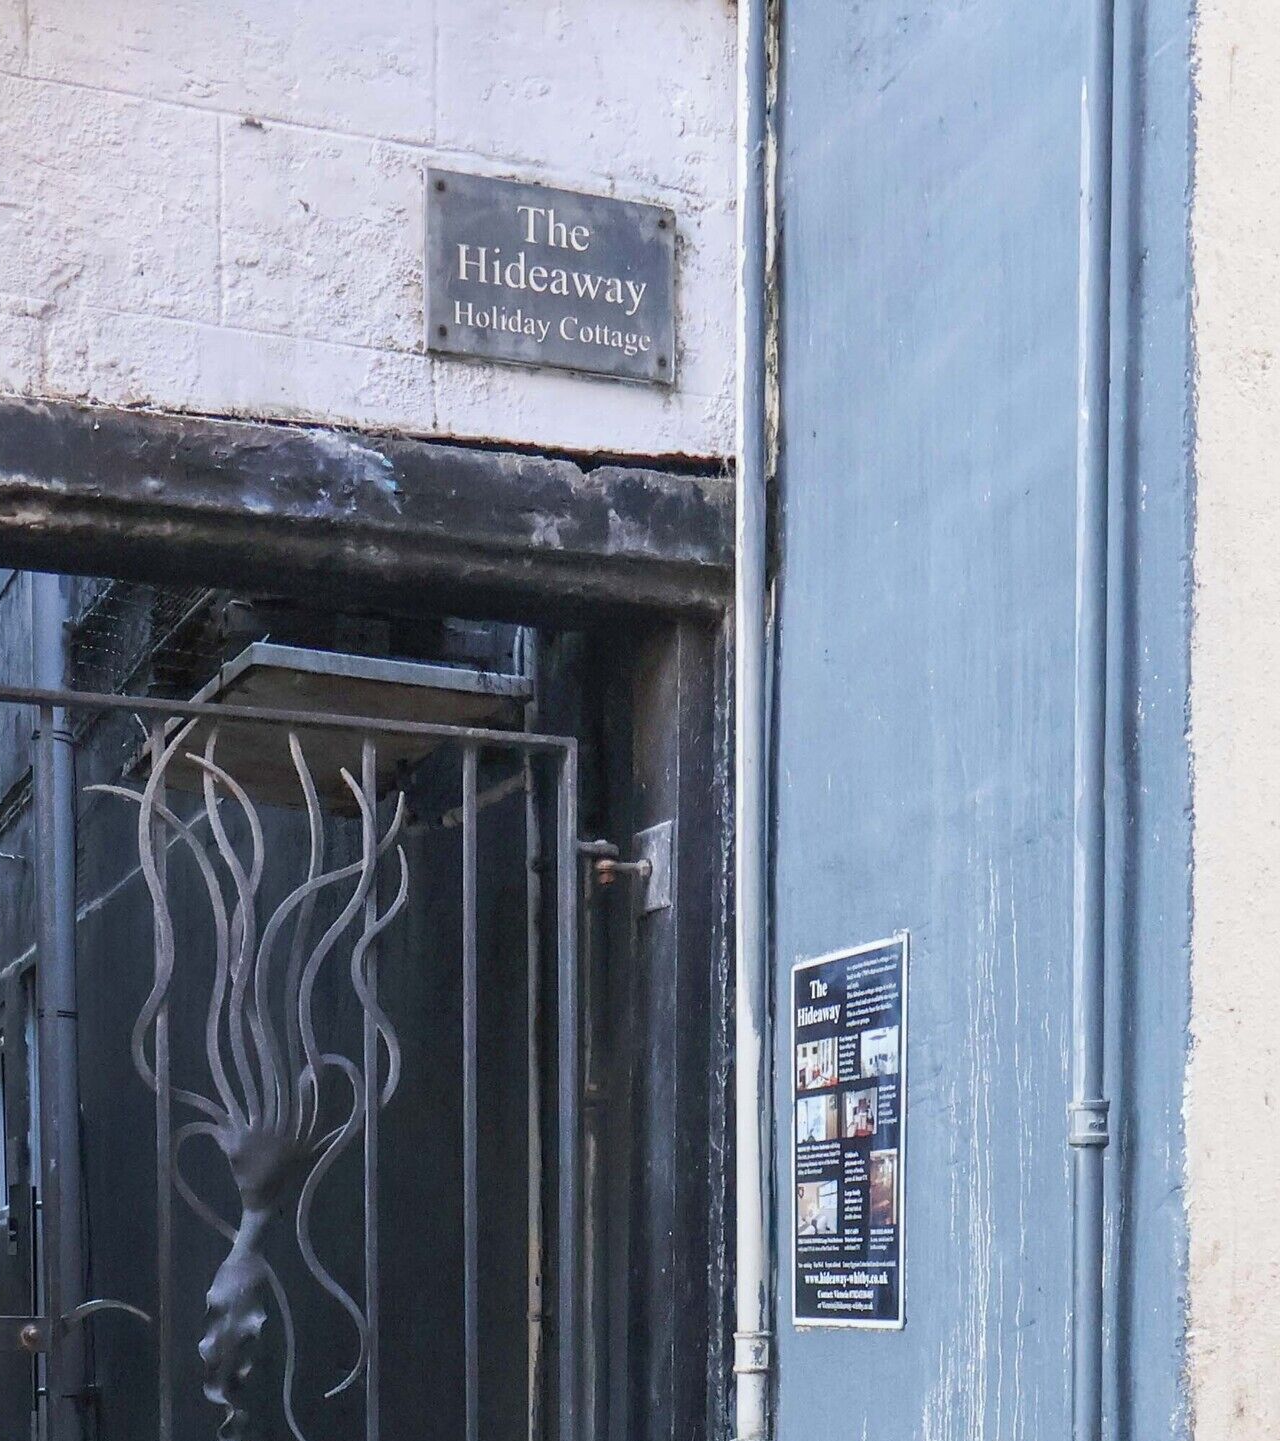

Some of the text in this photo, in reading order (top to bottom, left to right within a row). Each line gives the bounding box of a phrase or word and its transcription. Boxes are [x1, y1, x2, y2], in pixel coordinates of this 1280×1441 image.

[517, 206, 590, 252] The
[456, 243, 647, 316] Hideaway
[454, 300, 651, 356] Holiday Cottage
[809, 979, 828, 999] The
[797, 1004, 841, 1027] Hideaway
